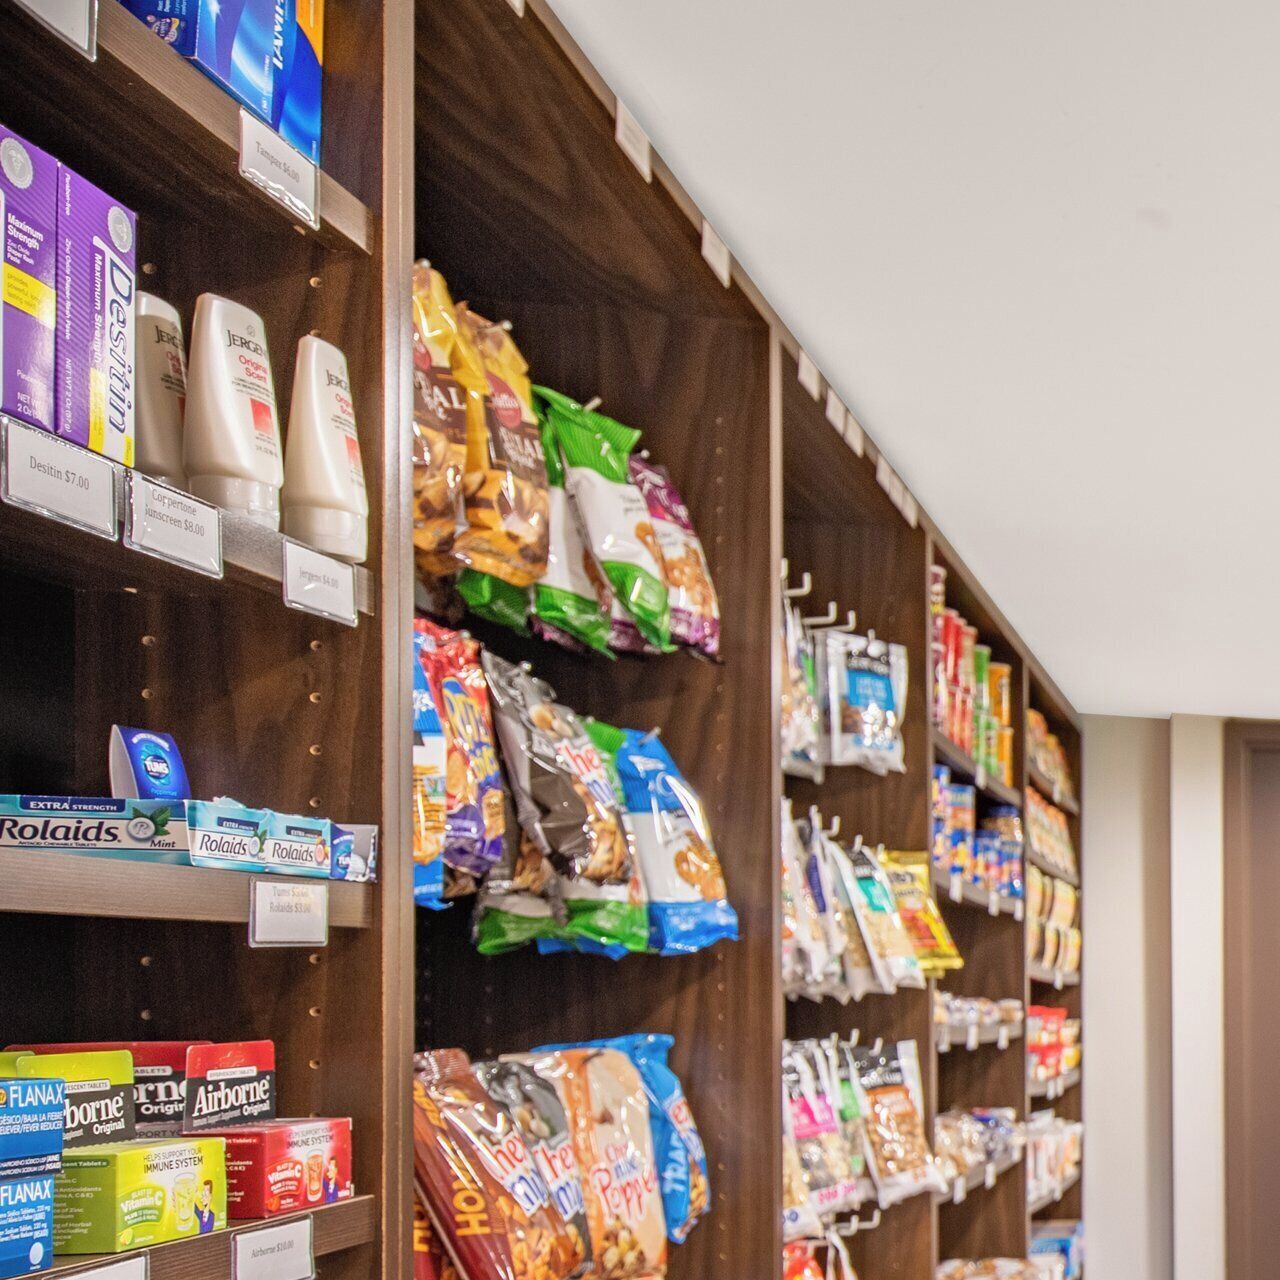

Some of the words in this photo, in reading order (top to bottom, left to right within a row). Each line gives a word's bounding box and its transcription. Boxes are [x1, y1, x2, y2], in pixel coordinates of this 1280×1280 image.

[255, 141, 284, 172] Tampax
[7, 211, 44, 243] Maximum
[7, 224, 40, 252] Strength
[93, 251, 104, 314] Maximum
[108, 250, 133, 434] Desitin
[29, 455, 63, 481] Desitin
[64, 469, 90, 492] $7.00
[151, 487, 197, 518] Coppertone
[183, 518, 206, 538] $8.00
[299, 565, 322, 586] Jergens
[144, 759, 170, 776] TUMS
[29, 799, 70, 812] EXTRA
[72, 801, 118, 813] STRENGTH
[0, 816, 121, 844] Rolaids
[150, 838, 176, 850] Mint
[199, 833, 248, 857] Rolaids
[270, 841, 314, 864] Rolaids
[269, 901, 293, 914] Rolaids
[9, 1083, 65, 1109] FLANAX
[191, 1075, 272, 1117] Airborne
[242, 1100, 271, 1117] Original
[92, 1117, 126, 1136] Original
[143, 1151, 161, 1162] HELPS
[161, 1149, 187, 1161] SUPPORT
[143, 1160, 174, 1174] IMMUNE
[175, 1155, 204, 1169] SYSTEM
[0, 1178, 52, 1208] FLANAX
[250, 1244, 276, 1260] Airborne
